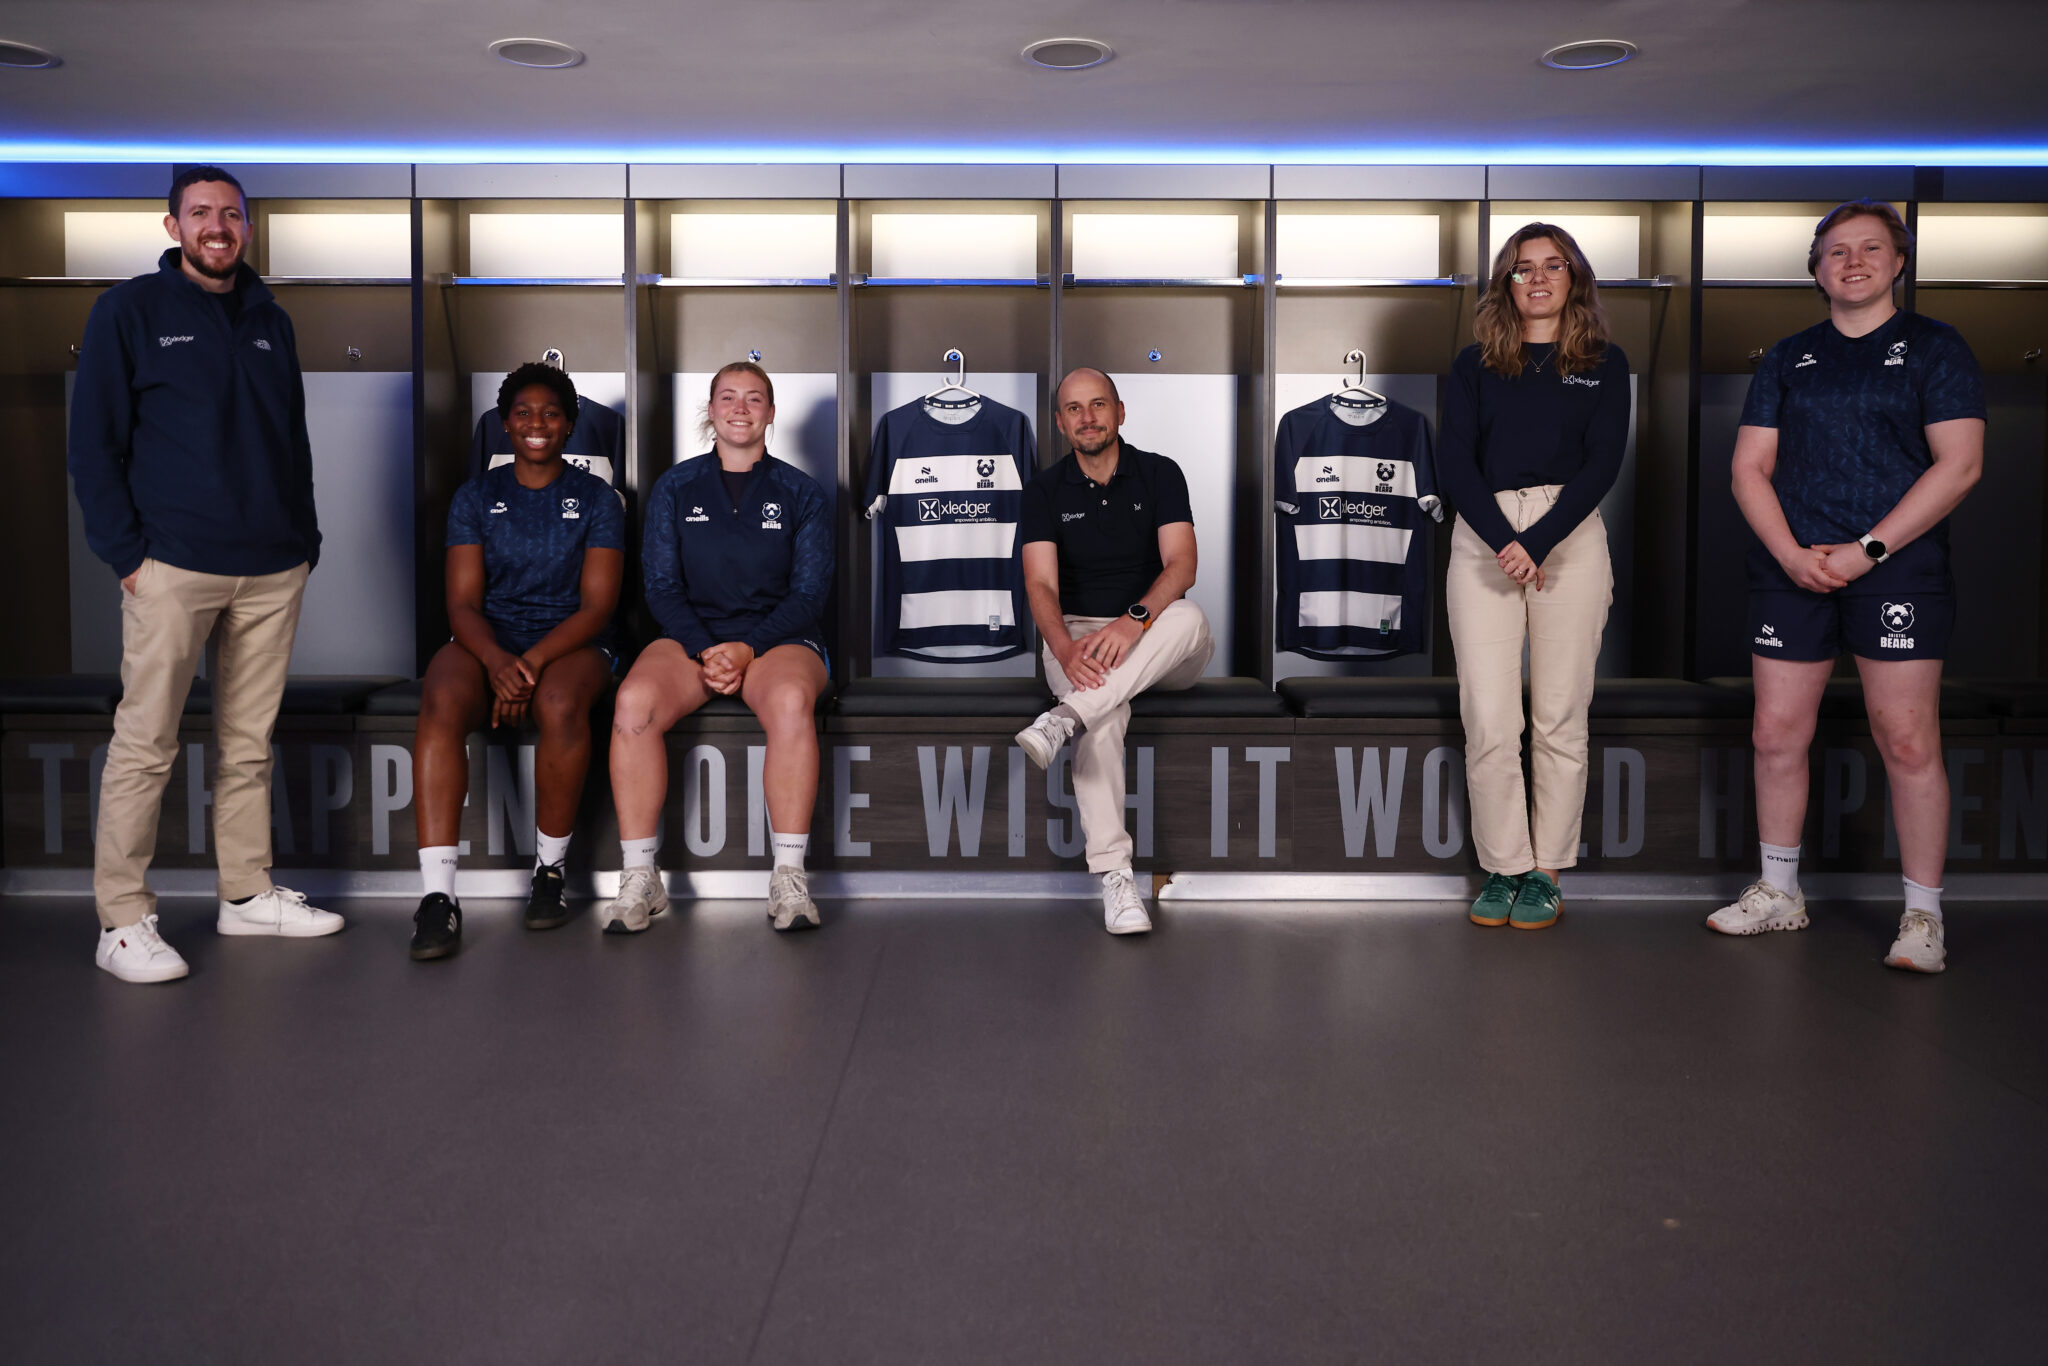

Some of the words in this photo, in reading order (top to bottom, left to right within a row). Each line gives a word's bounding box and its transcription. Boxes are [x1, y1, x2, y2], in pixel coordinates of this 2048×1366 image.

[1574, 377, 1600, 387] xledger
[941, 500, 991, 518] xledger
[1341, 499, 1387, 519] xledger
[1880, 636, 1914, 649] BEARS
[1211, 746, 1291, 858] IT
[1334, 746, 1646, 859] WOD
